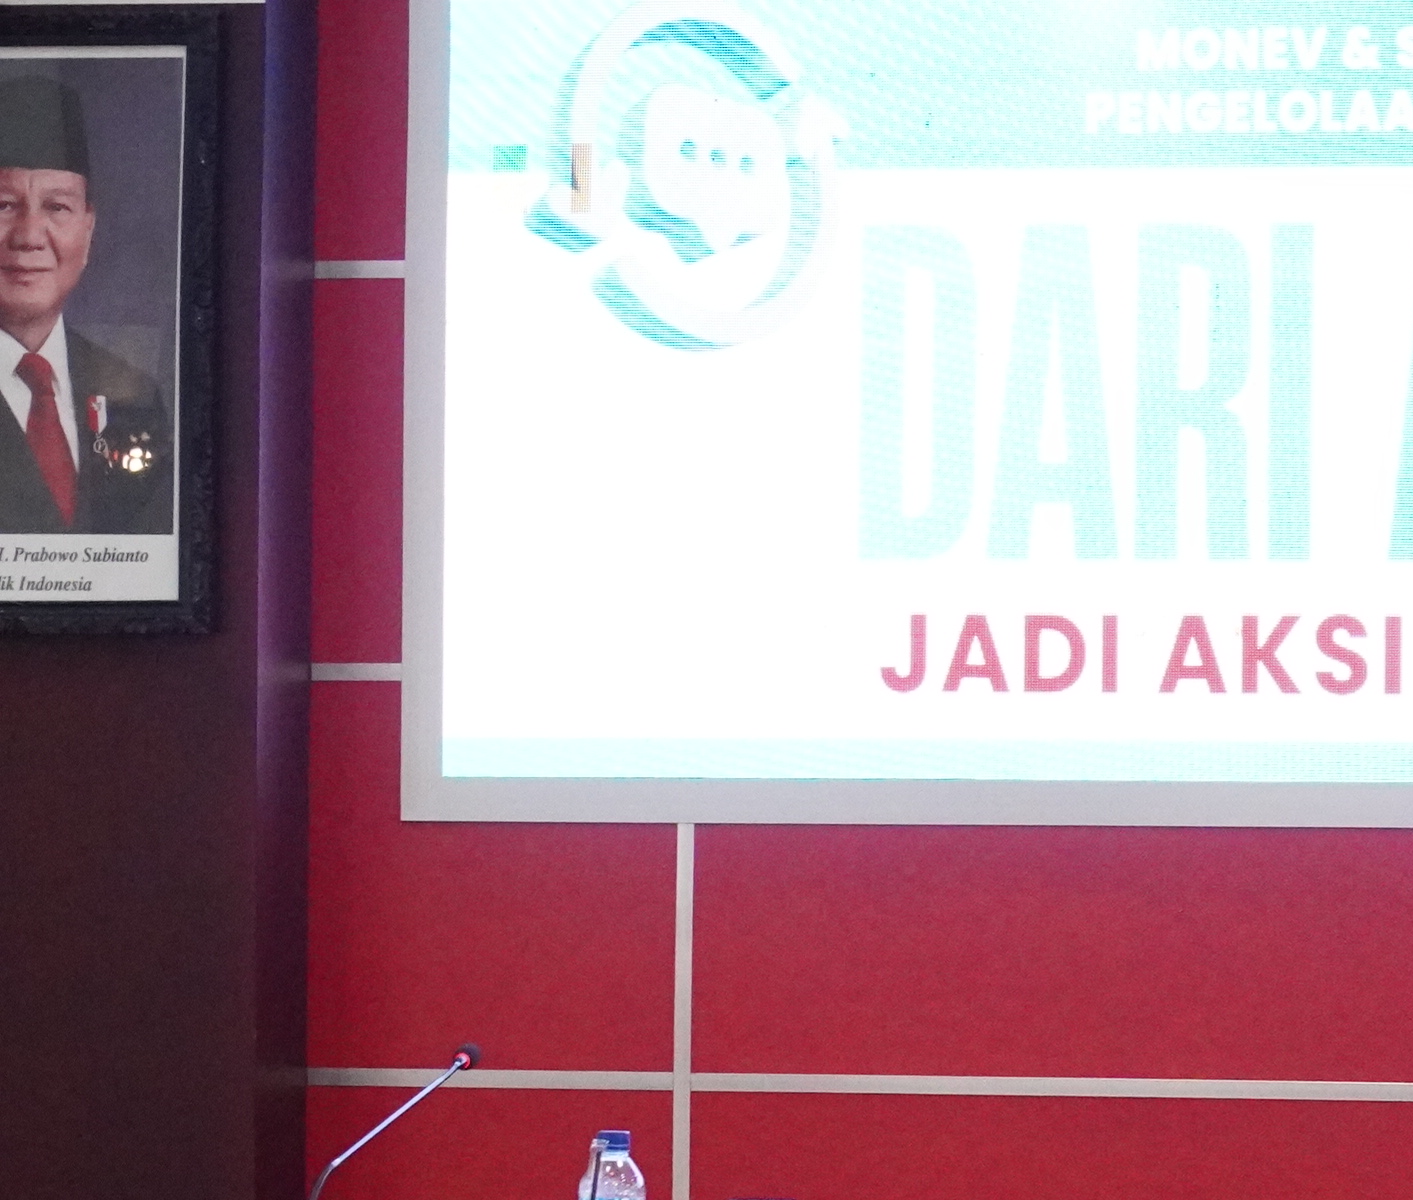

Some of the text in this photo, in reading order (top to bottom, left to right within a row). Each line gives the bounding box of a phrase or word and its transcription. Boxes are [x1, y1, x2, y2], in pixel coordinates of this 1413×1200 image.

[1135, 26, 1328, 71] MONEV
[1341, 26, 1381, 70] &
[857, 220, 1316, 564] DARI
[13, 547, 78, 562] Prabowo
[82, 547, 149, 562] Subianto
[19, 576, 92, 591] Indonesia
[879, 613, 1118, 694] JADI
[1158, 613, 1402, 695] AKSI
